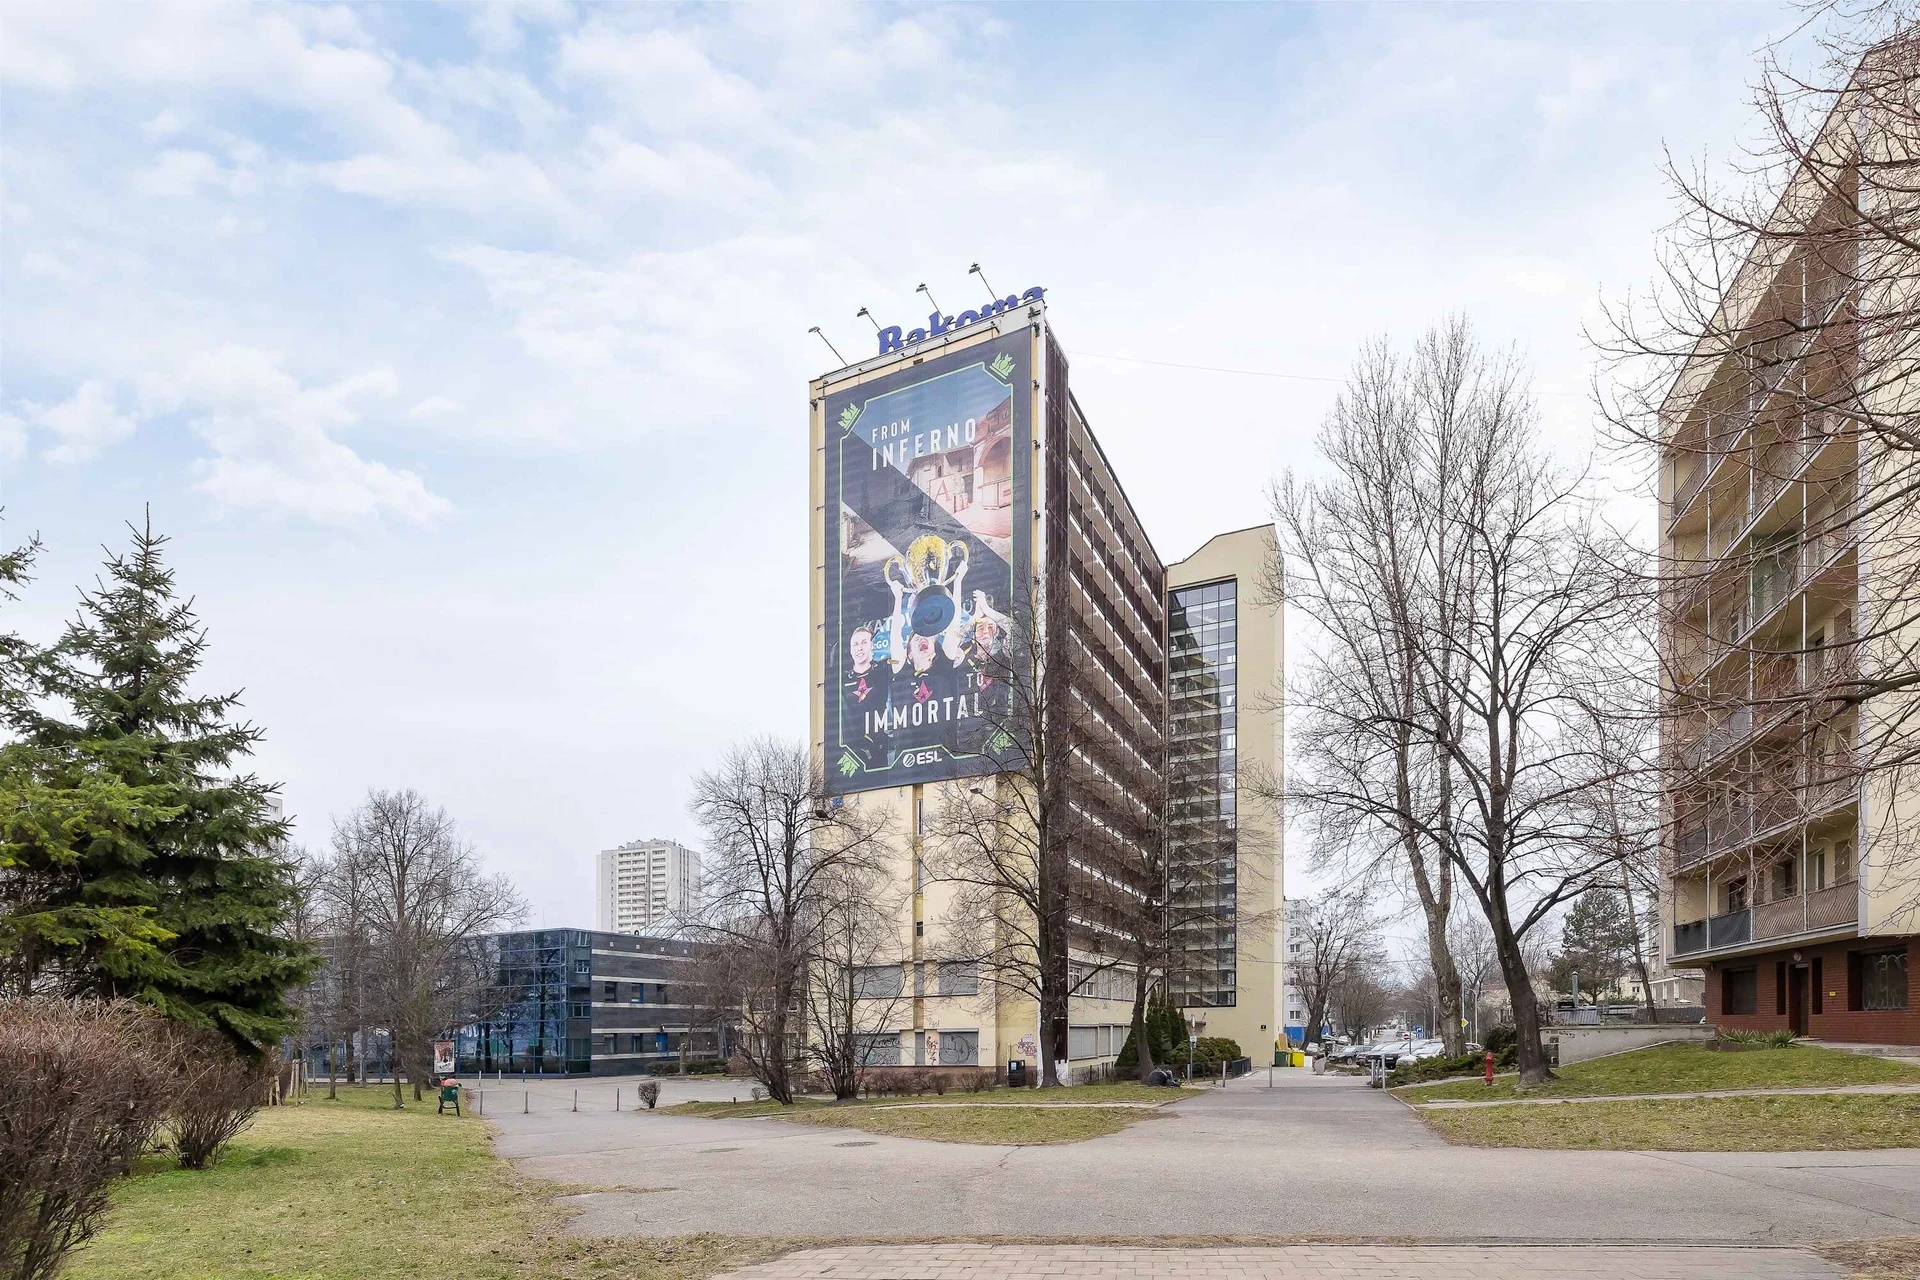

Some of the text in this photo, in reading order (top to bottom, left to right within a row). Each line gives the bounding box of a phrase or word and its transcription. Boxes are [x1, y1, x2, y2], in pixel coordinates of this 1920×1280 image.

[872, 418, 910, 443] FROM
[872, 418, 976, 471] INFERNO
[966, 672, 983, 688] TO
[864, 692, 983, 735] IMMORTAL
[916, 750, 942, 764] ESL
